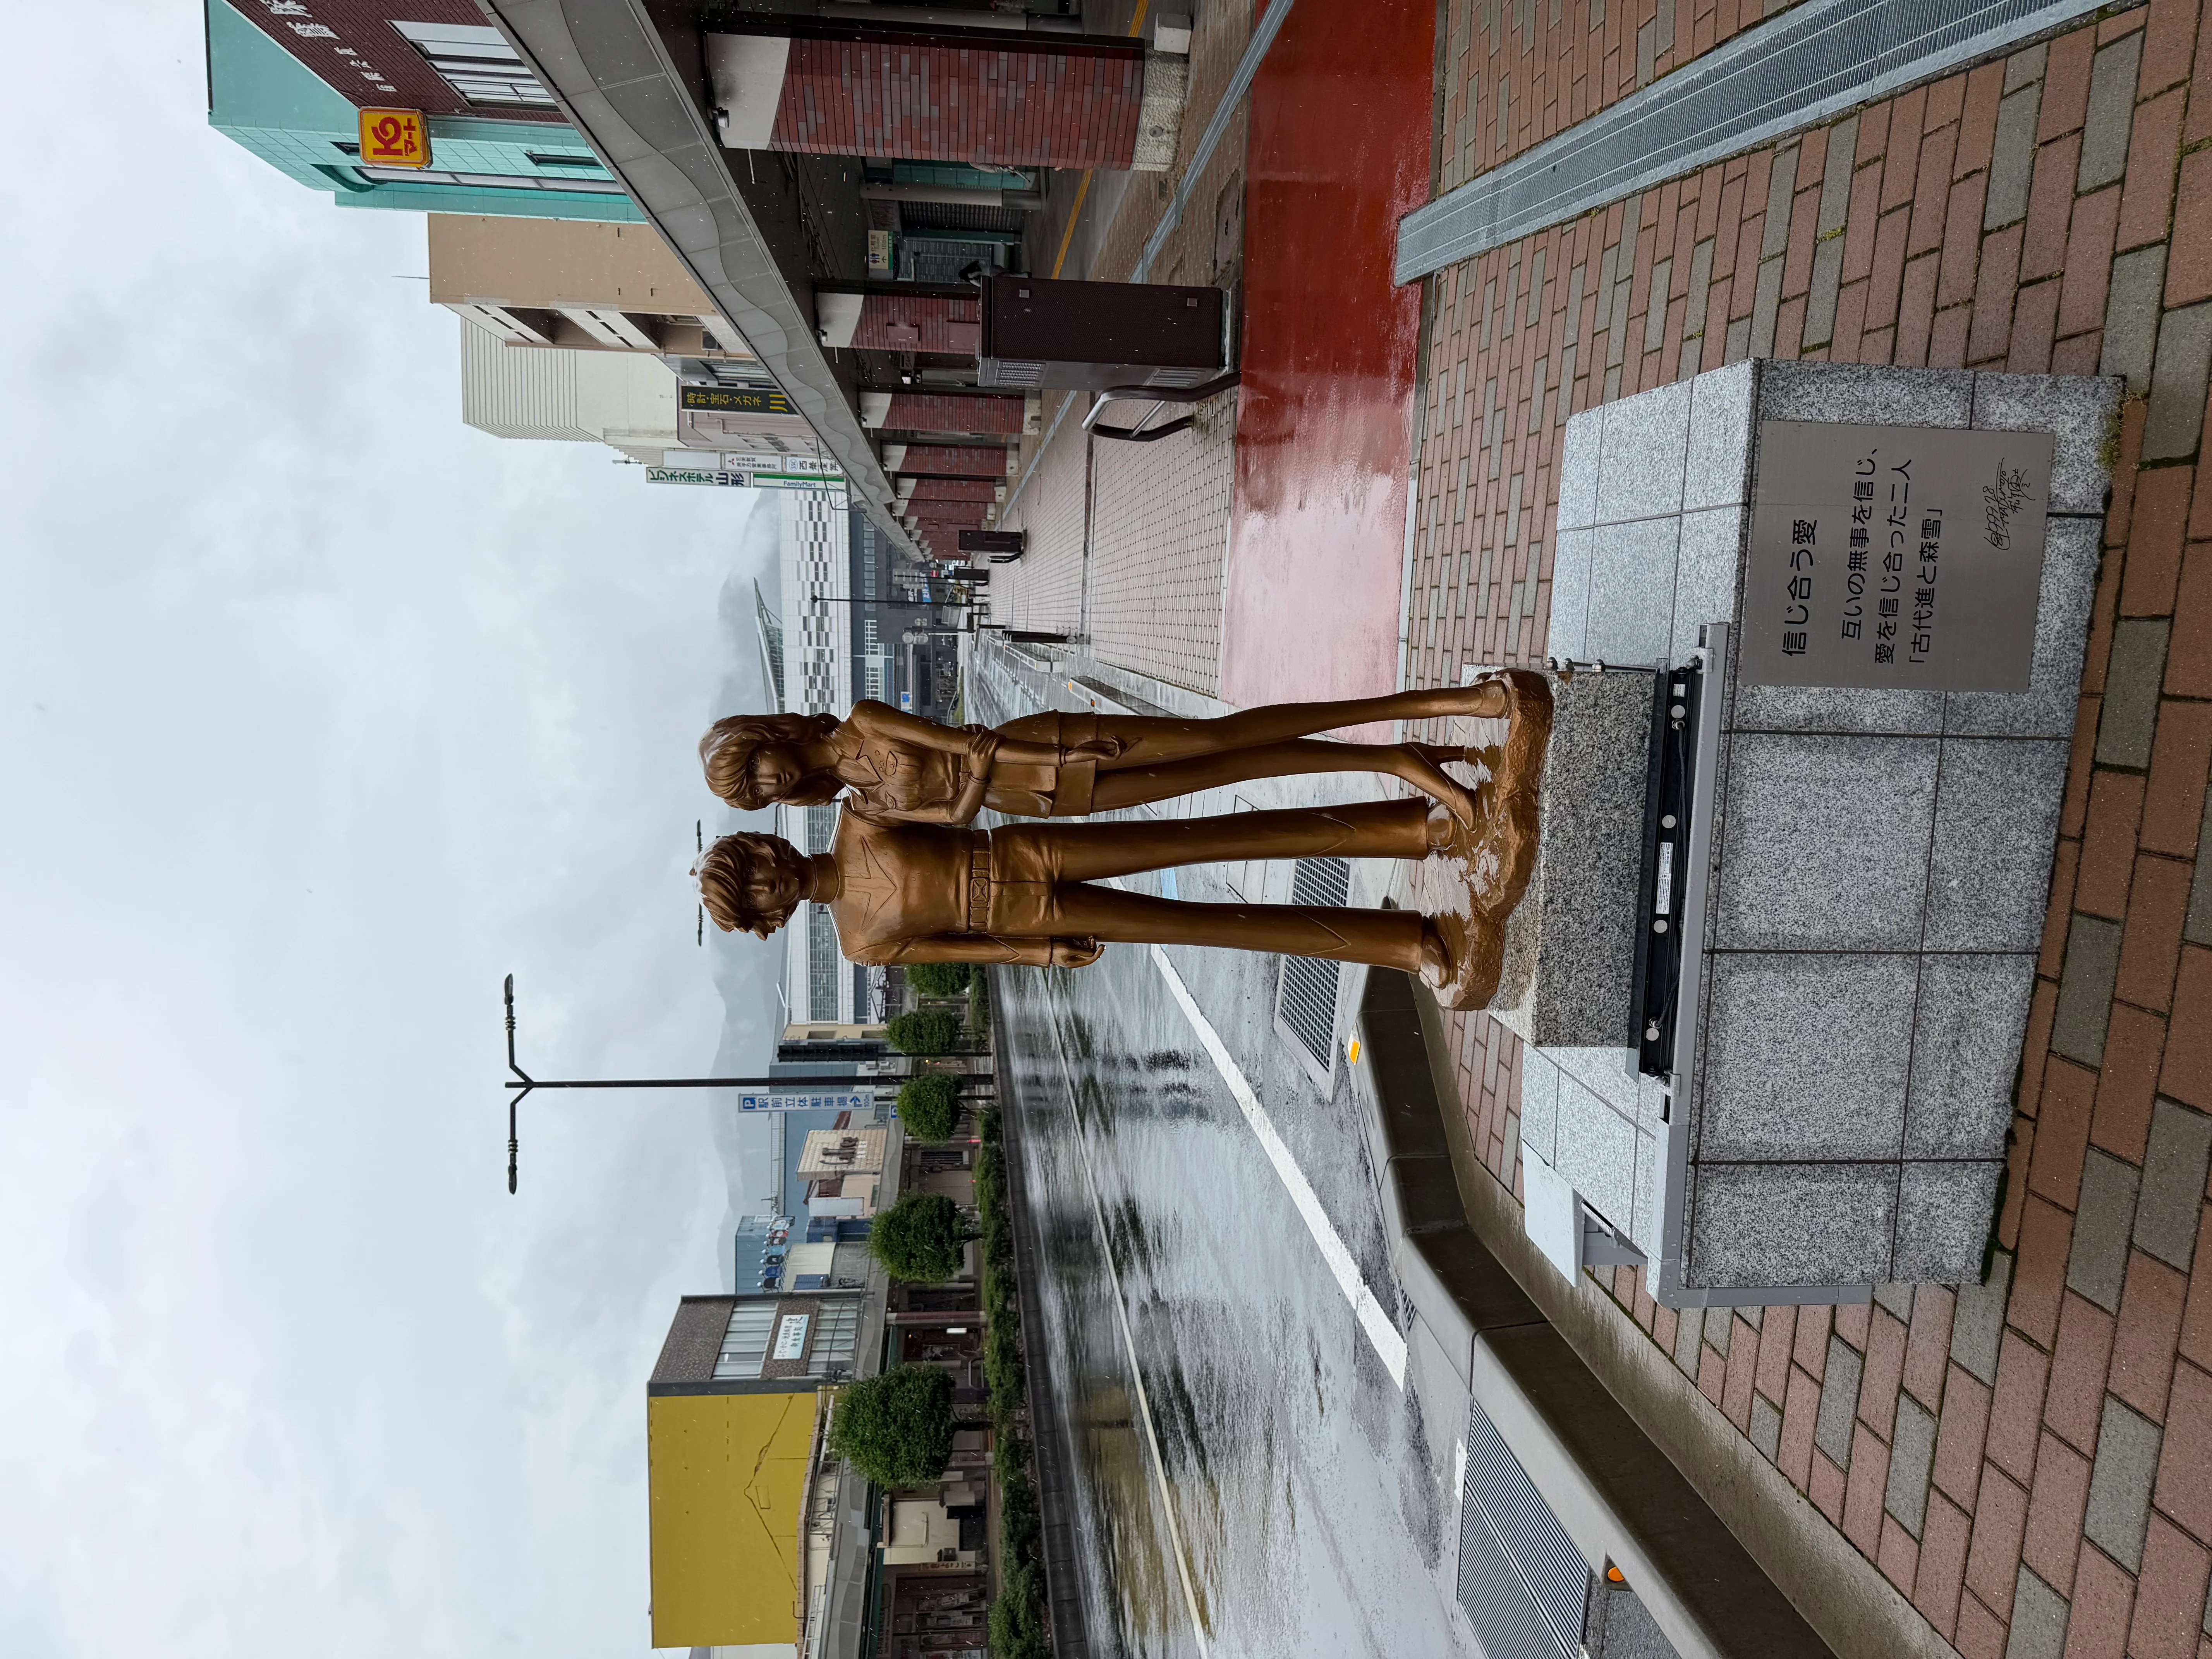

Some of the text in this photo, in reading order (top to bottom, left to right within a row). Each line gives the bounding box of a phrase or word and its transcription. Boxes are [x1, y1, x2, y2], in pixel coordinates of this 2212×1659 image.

[403, 118, 417, 156] マート
[687, 392, 762, 406] 時計・宝石・メガネ
[648, 469, 745, 486] ビジネスホテル 山形
[1781, 519, 1818, 656] 信じ合う愛
[1841, 448, 1877, 640] 互いの無事を信じ、
[1874, 459, 1912, 665] 愛を信じ合った二人
[1908, 508, 1942, 663] 「古代進と森雪」
[758, 1096, 848, 1108] 駅前立体駐車場
